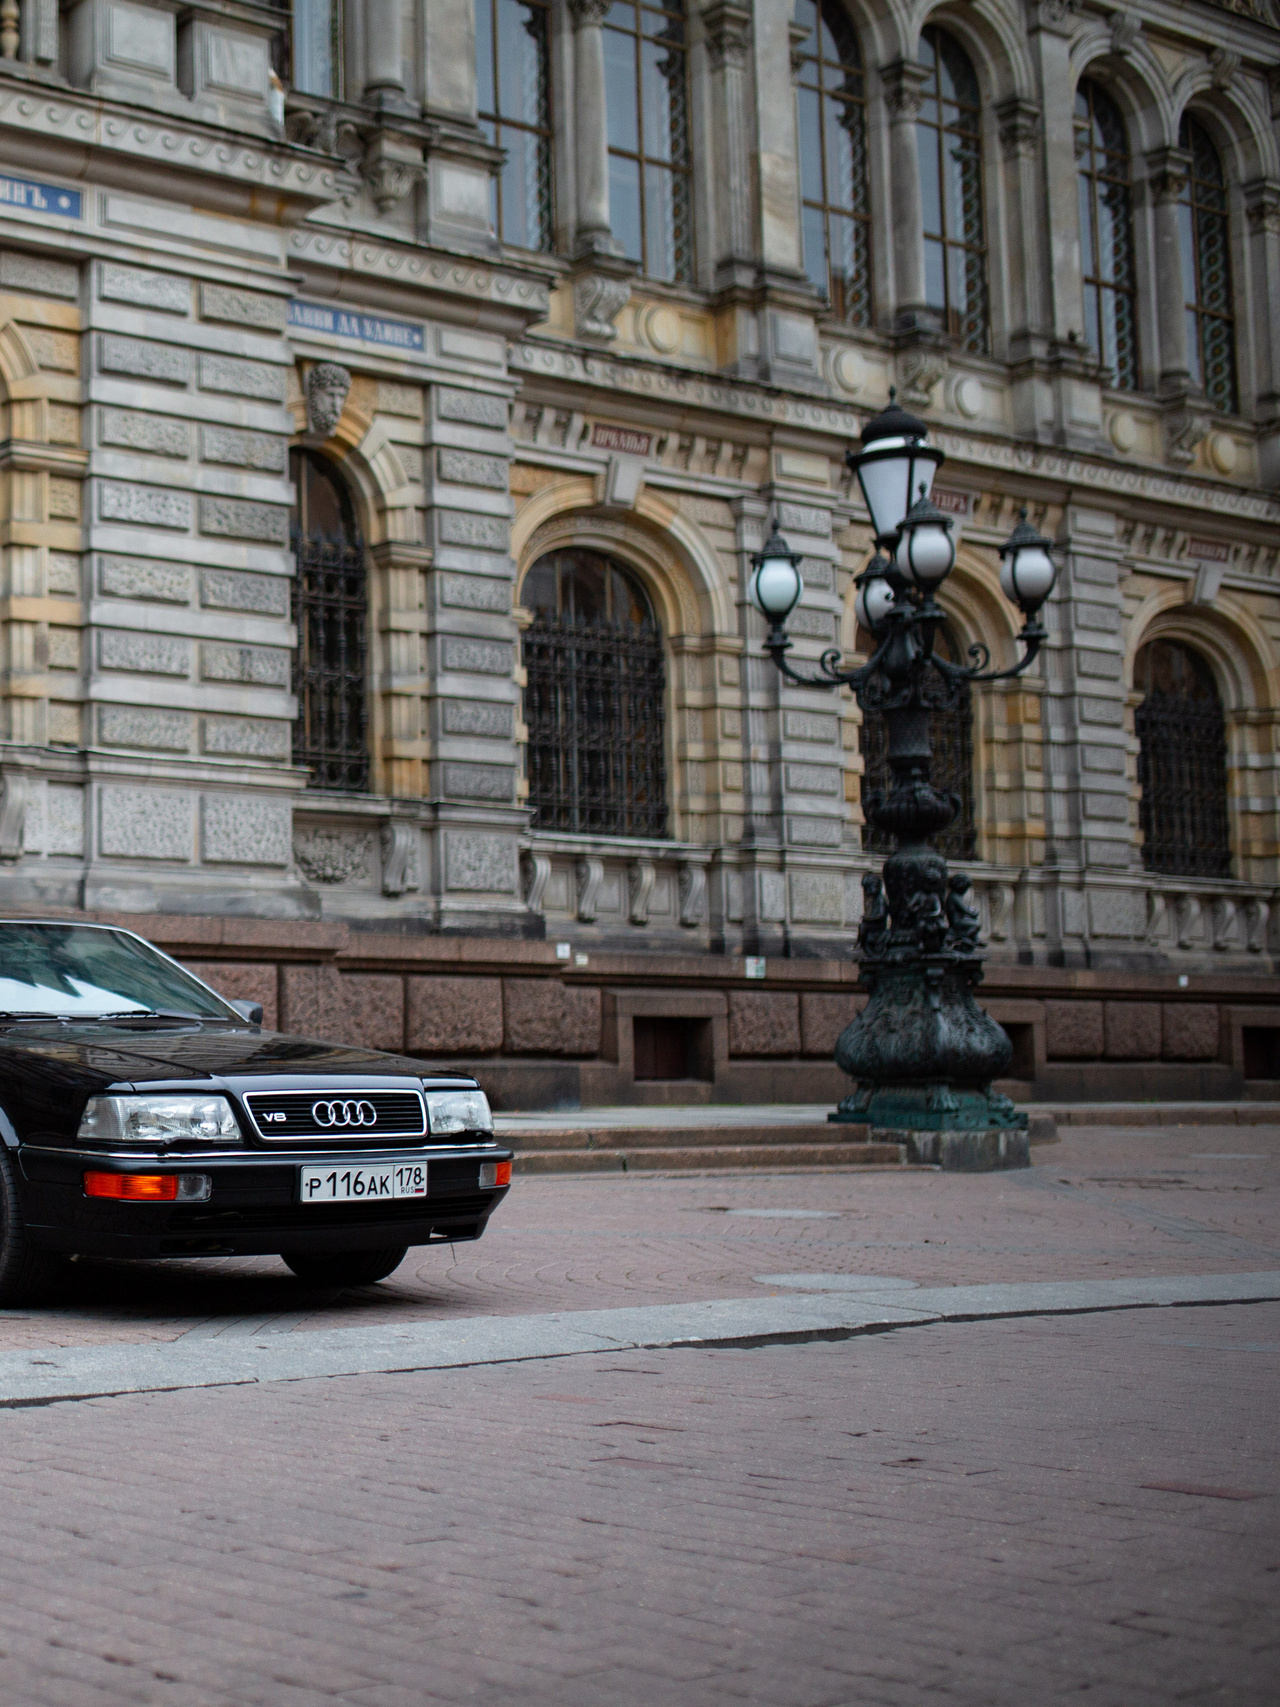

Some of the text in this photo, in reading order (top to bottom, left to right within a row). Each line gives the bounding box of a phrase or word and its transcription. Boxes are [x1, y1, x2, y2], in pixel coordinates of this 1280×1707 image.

[287, 303, 334, 331] АННИ
[262, 1112, 286, 1122] V8
[401, 1186, 415, 1194] RUS
